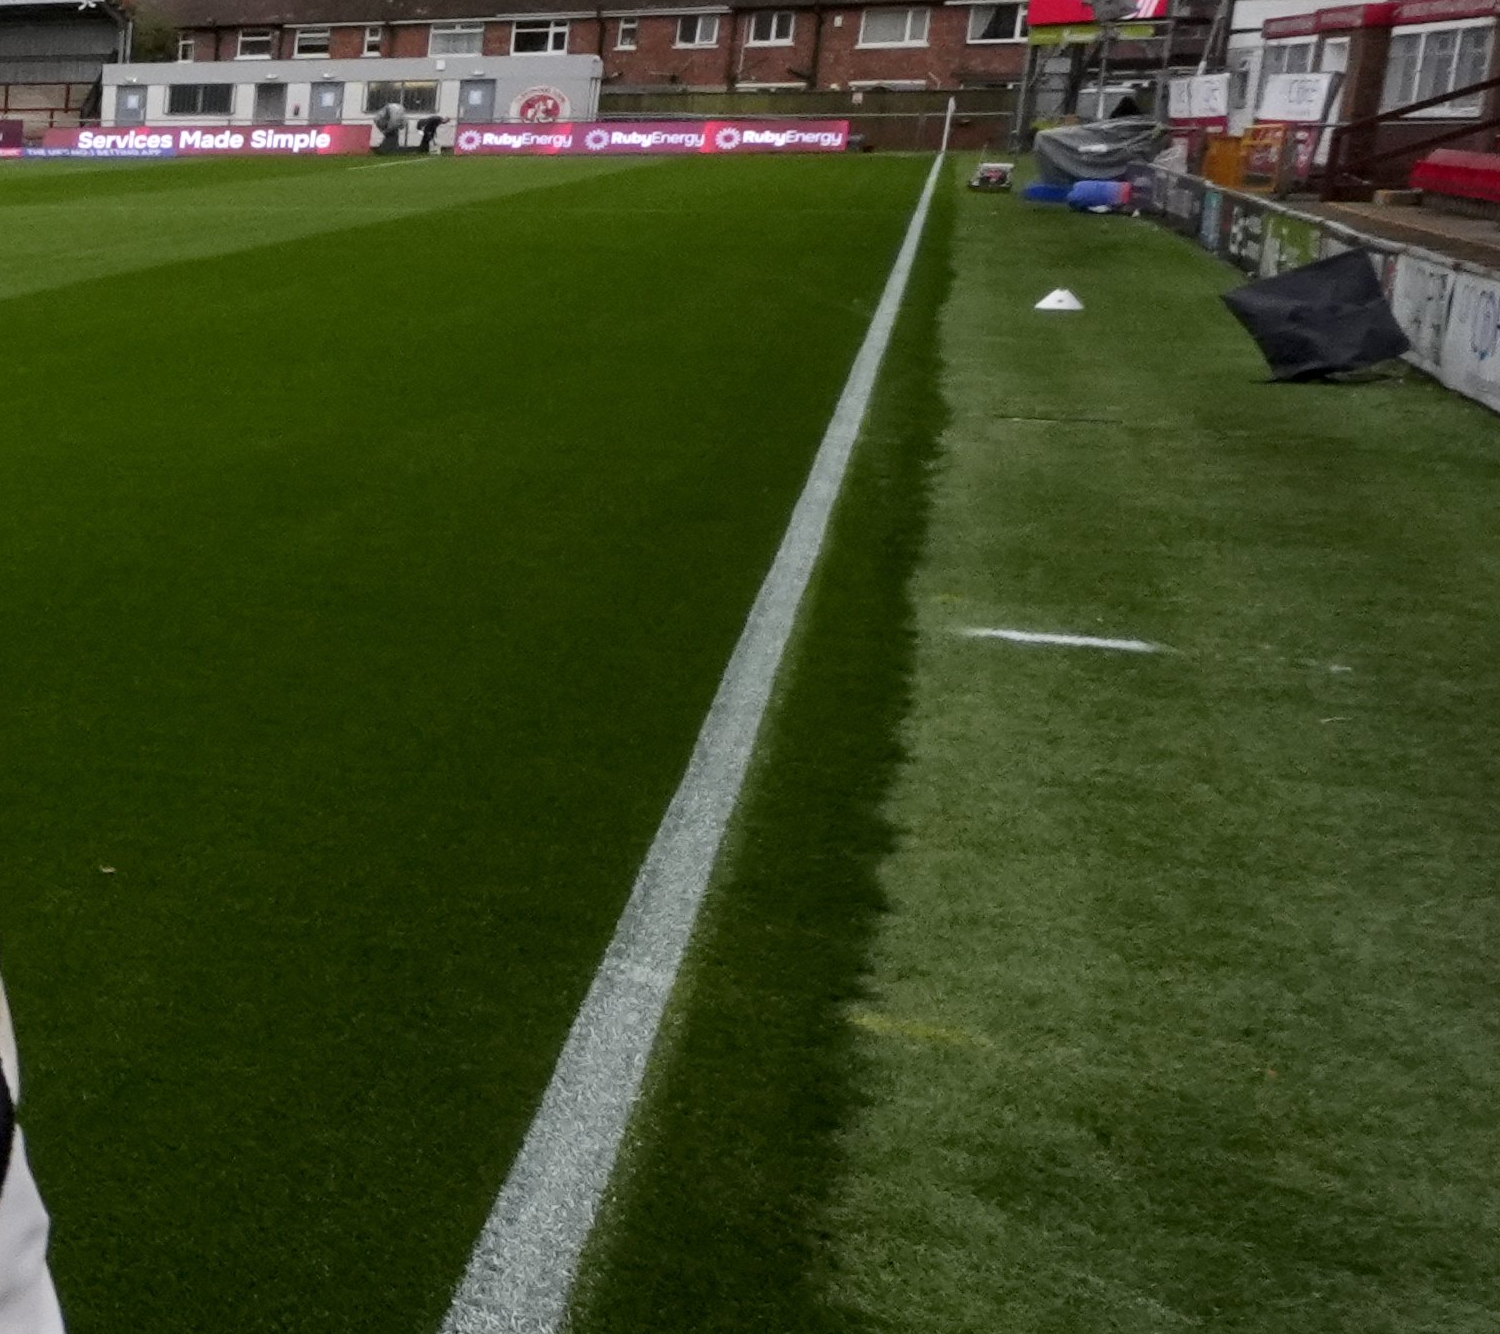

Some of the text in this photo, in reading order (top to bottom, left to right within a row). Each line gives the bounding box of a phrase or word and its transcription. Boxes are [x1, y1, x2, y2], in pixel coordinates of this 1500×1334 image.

[77, 129, 331, 153] Services Made Simple
[482, 131, 573, 150] RubyEnergy
[610, 130, 706, 149] RubyEnergy
[742, 129, 843, 148] RubyEnergy
